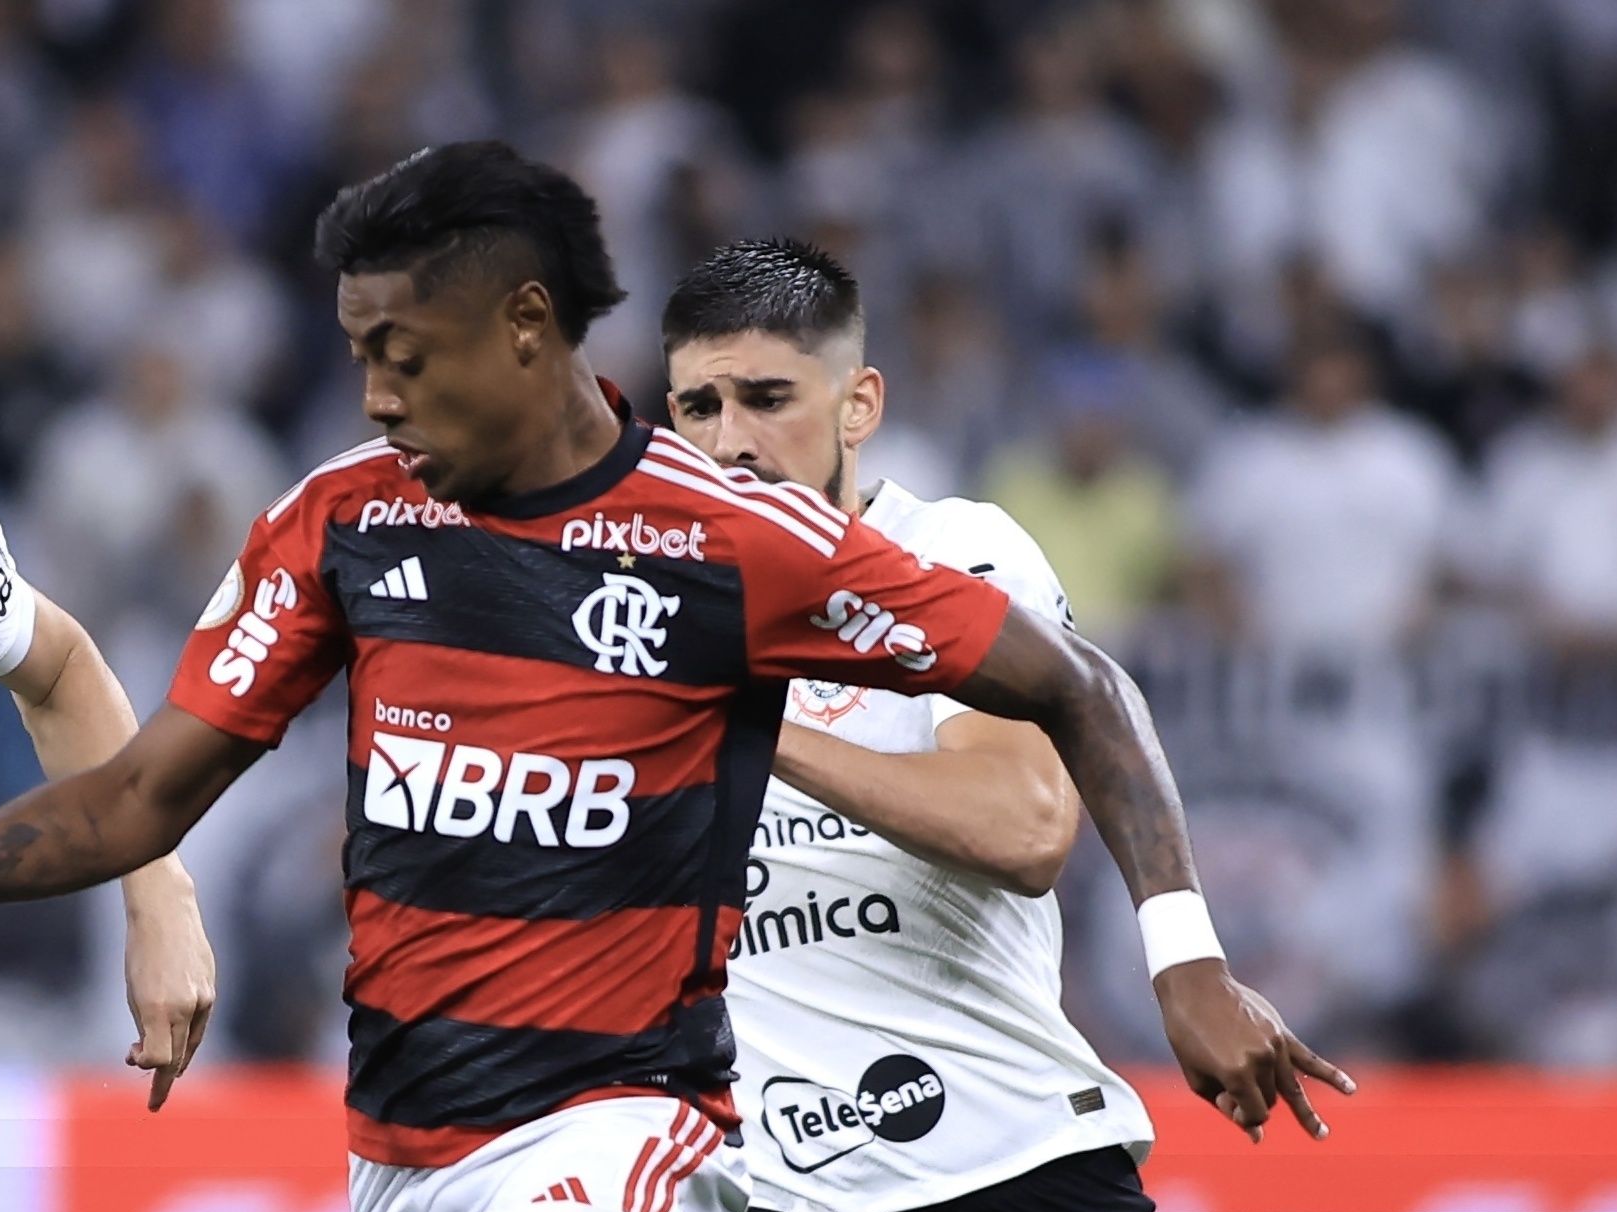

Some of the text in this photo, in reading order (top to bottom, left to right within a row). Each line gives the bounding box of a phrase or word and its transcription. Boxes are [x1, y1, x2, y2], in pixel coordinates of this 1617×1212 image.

[560, 512, 708, 561] pixbet
[375, 697, 453, 732] banco
[433, 744, 636, 848] BRB
